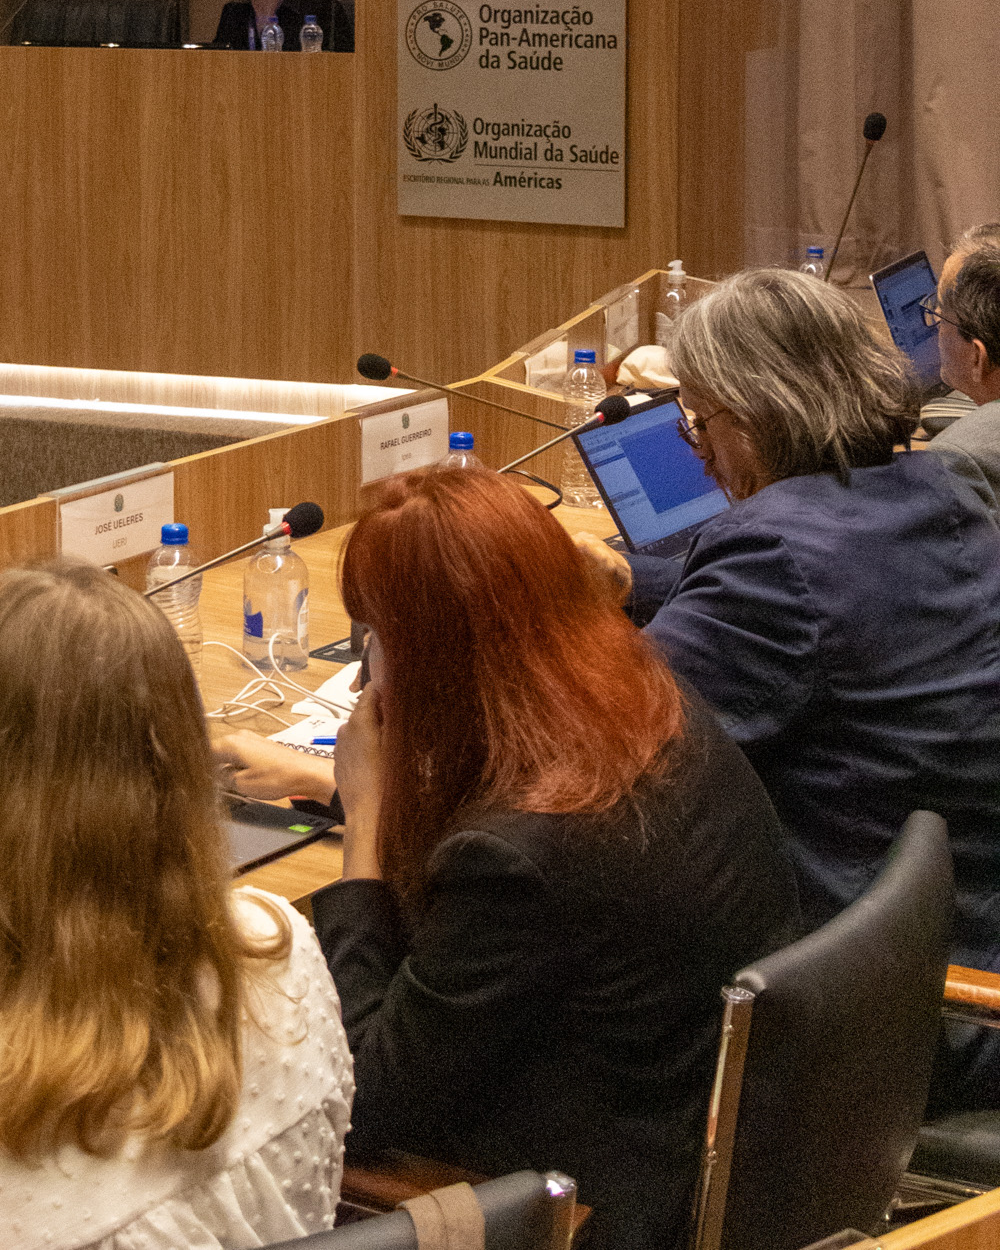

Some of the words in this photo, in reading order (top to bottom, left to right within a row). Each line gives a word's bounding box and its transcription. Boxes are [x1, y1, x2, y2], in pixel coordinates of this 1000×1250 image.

[478, 3, 594, 31] Organização
[478, 27, 618, 50] Pan-Americana
[478, 49, 501, 69] da
[507, 50, 564, 71] Saúde
[473, 117, 572, 143] Organização
[473, 141, 538, 161] Mundial
[544, 144, 564, 162] da
[569, 144, 620, 165] Saúde
[492, 171, 563, 190] Américas
[380, 438, 400, 450] RAFAEL
[401, 428, 432, 443] GUERREIRO
[95, 519, 112, 535] JOSÉ
[113, 512, 144, 530] UELERES
